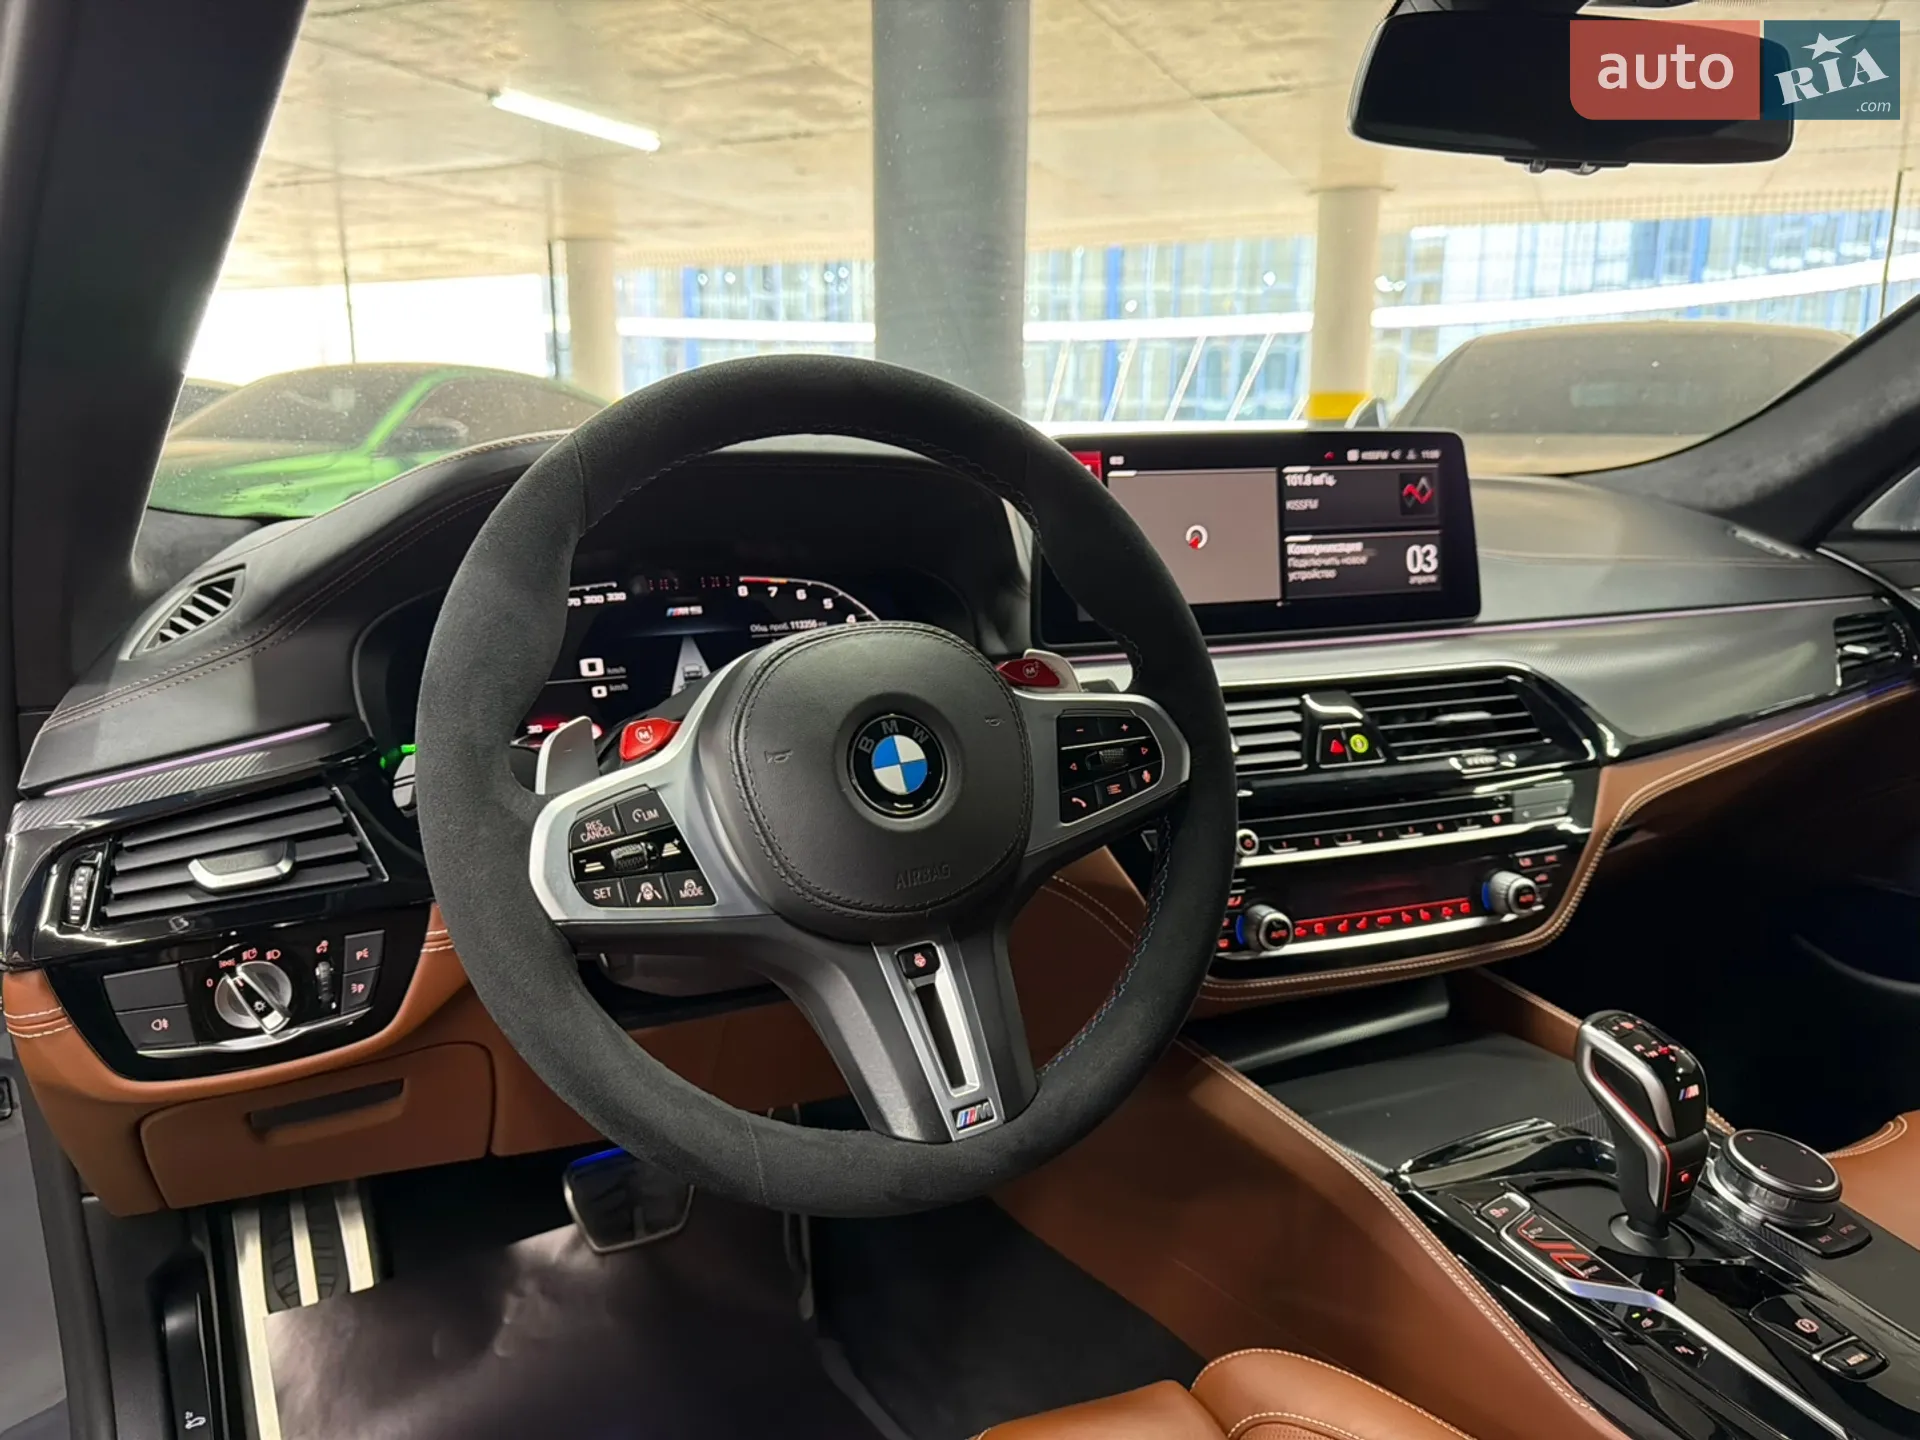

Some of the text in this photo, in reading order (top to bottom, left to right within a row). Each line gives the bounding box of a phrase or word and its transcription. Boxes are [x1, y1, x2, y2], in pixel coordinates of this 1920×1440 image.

[1406, 544, 1438, 573] 03
[767, 586, 778, 598] 7
[567, 598, 581, 607] 70
[579, 657, 605, 677] 0
[858, 719, 929, 754] BMW
[586, 819, 603, 831] RES
[580, 827, 615, 842] CANCEL
[896, 864, 951, 890] AIRBAG
[593, 887, 612, 900] SET
[679, 886, 704, 899] MODE
